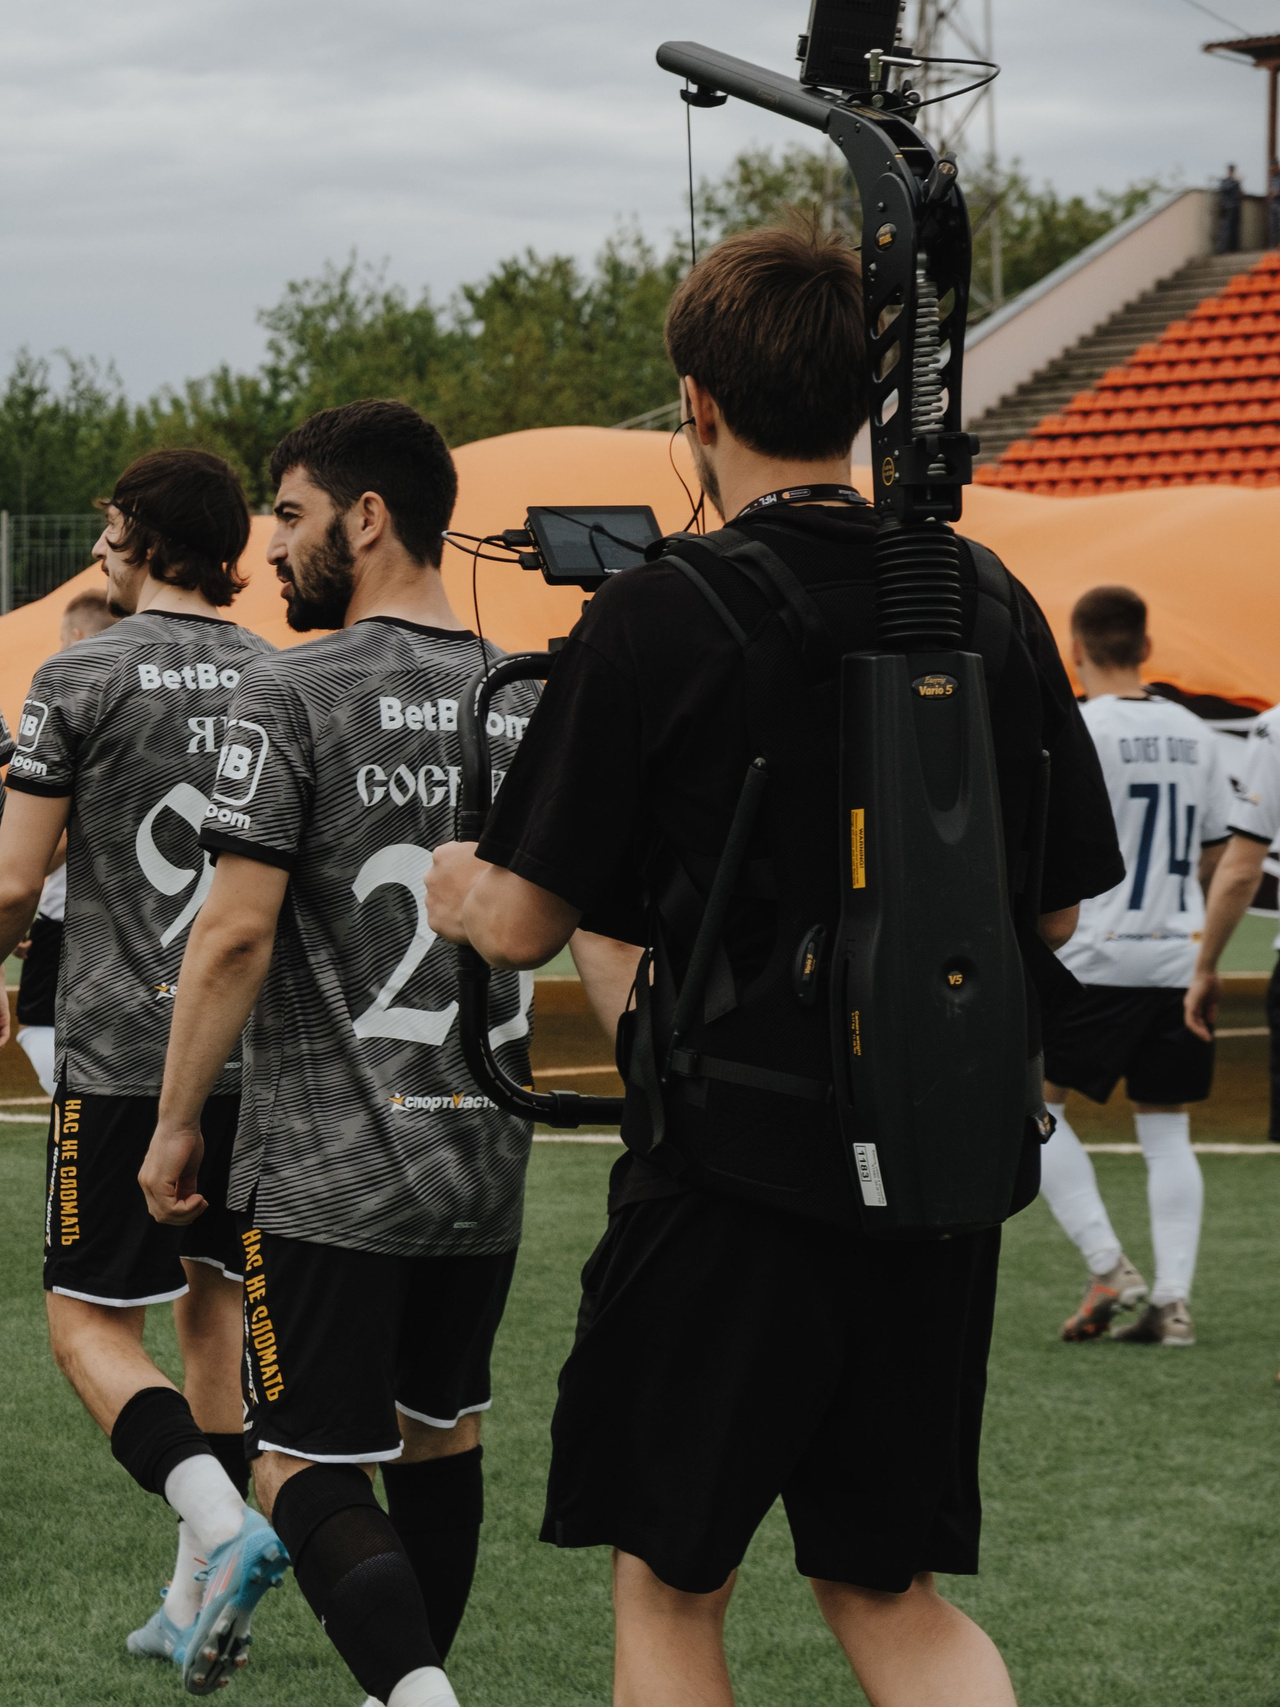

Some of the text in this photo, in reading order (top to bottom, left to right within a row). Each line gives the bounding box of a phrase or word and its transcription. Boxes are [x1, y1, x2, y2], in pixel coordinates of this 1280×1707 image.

[137, 663, 241, 690] BetBo
[919, 684, 953, 696] Vario 5
[1128, 782, 1197, 912] 74
[948, 974, 962, 985] V5
[60, 1099, 82, 1246] НАС НЕ СЛОМАТЬ
[858, 1150, 869, 1179] 1183
[241, 1228, 263, 1271] НАС
[245, 1273, 266, 1304] НЕ
[251, 1305, 285, 1402] СЛОМАТЬ
